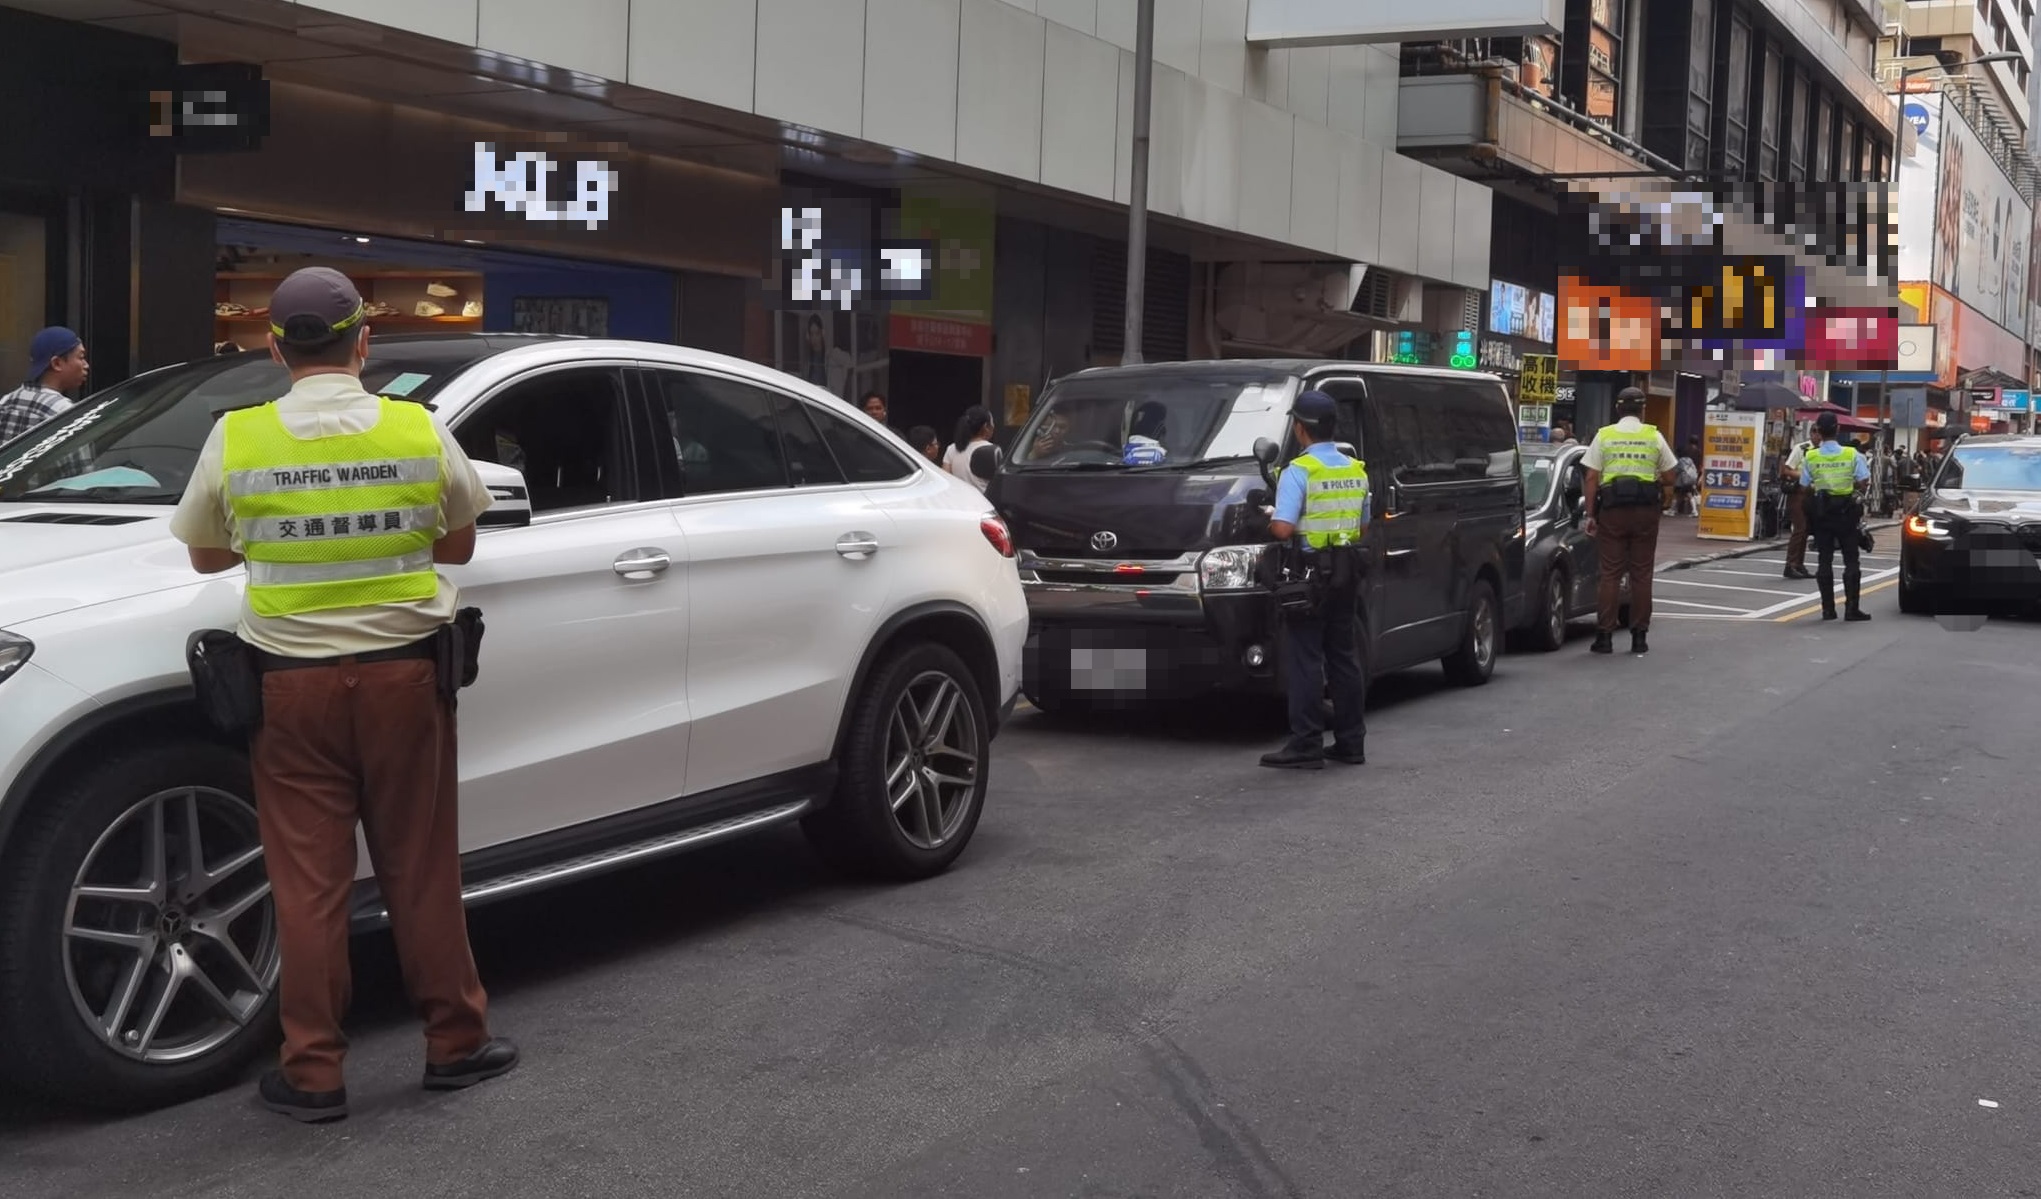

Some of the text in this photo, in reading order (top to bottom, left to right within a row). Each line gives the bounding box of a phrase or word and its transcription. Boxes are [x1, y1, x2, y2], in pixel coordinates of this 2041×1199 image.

[1522, 375, 1554, 394] 收機
[273, 464, 398, 486] TRAFFIC WARDEN
[1330, 480, 1354, 489] POLICE
[1706, 472, 1741, 487] $18
[279, 511, 402, 538] 交通督導員
